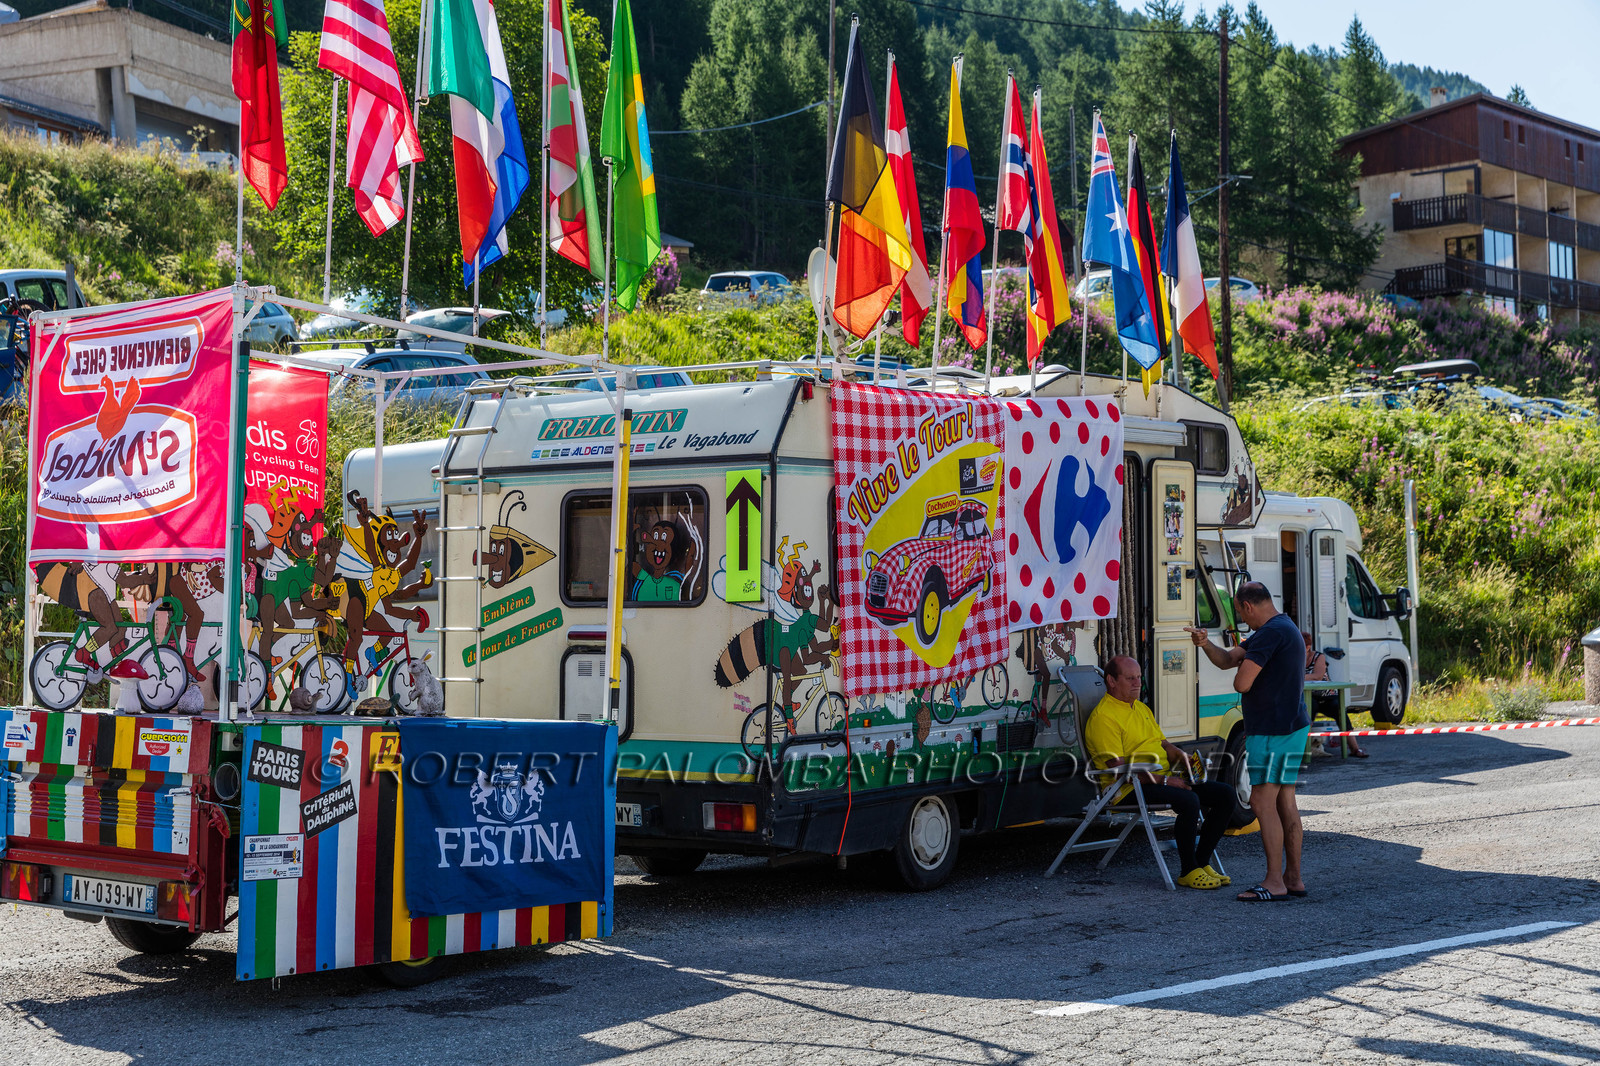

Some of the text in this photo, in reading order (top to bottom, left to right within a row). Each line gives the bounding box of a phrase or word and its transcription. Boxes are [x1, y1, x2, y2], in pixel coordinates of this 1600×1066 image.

[246, 420, 287, 451] dis
[539, 411, 684, 439] FRELOTIN
[571, 446, 605, 457] ALDEN
[658, 436, 677, 450] Le
[683, 430, 759, 451] Vagabond
[253, 452, 296, 470] Cycling
[848, 402, 973, 527] Vive le Tour!
[244, 470, 319, 502] UPPORTER
[926, 500, 957, 514] Cochonou
[483, 595, 530, 624] Emblème
[482, 641, 502, 657] tour
[504, 633, 517, 647] de
[520, 616, 558, 640] France
[256, 747, 300, 768] PARIS
[330, 740, 349, 768] 2
[376, 736, 402, 764] F
[252, 760, 300, 784] TOURS
[322, 806, 330, 814] du
[616, 806, 632, 823] WY
[435, 821, 581, 868] FESTINA
[74, 880, 143, 908] AY-039-WY
